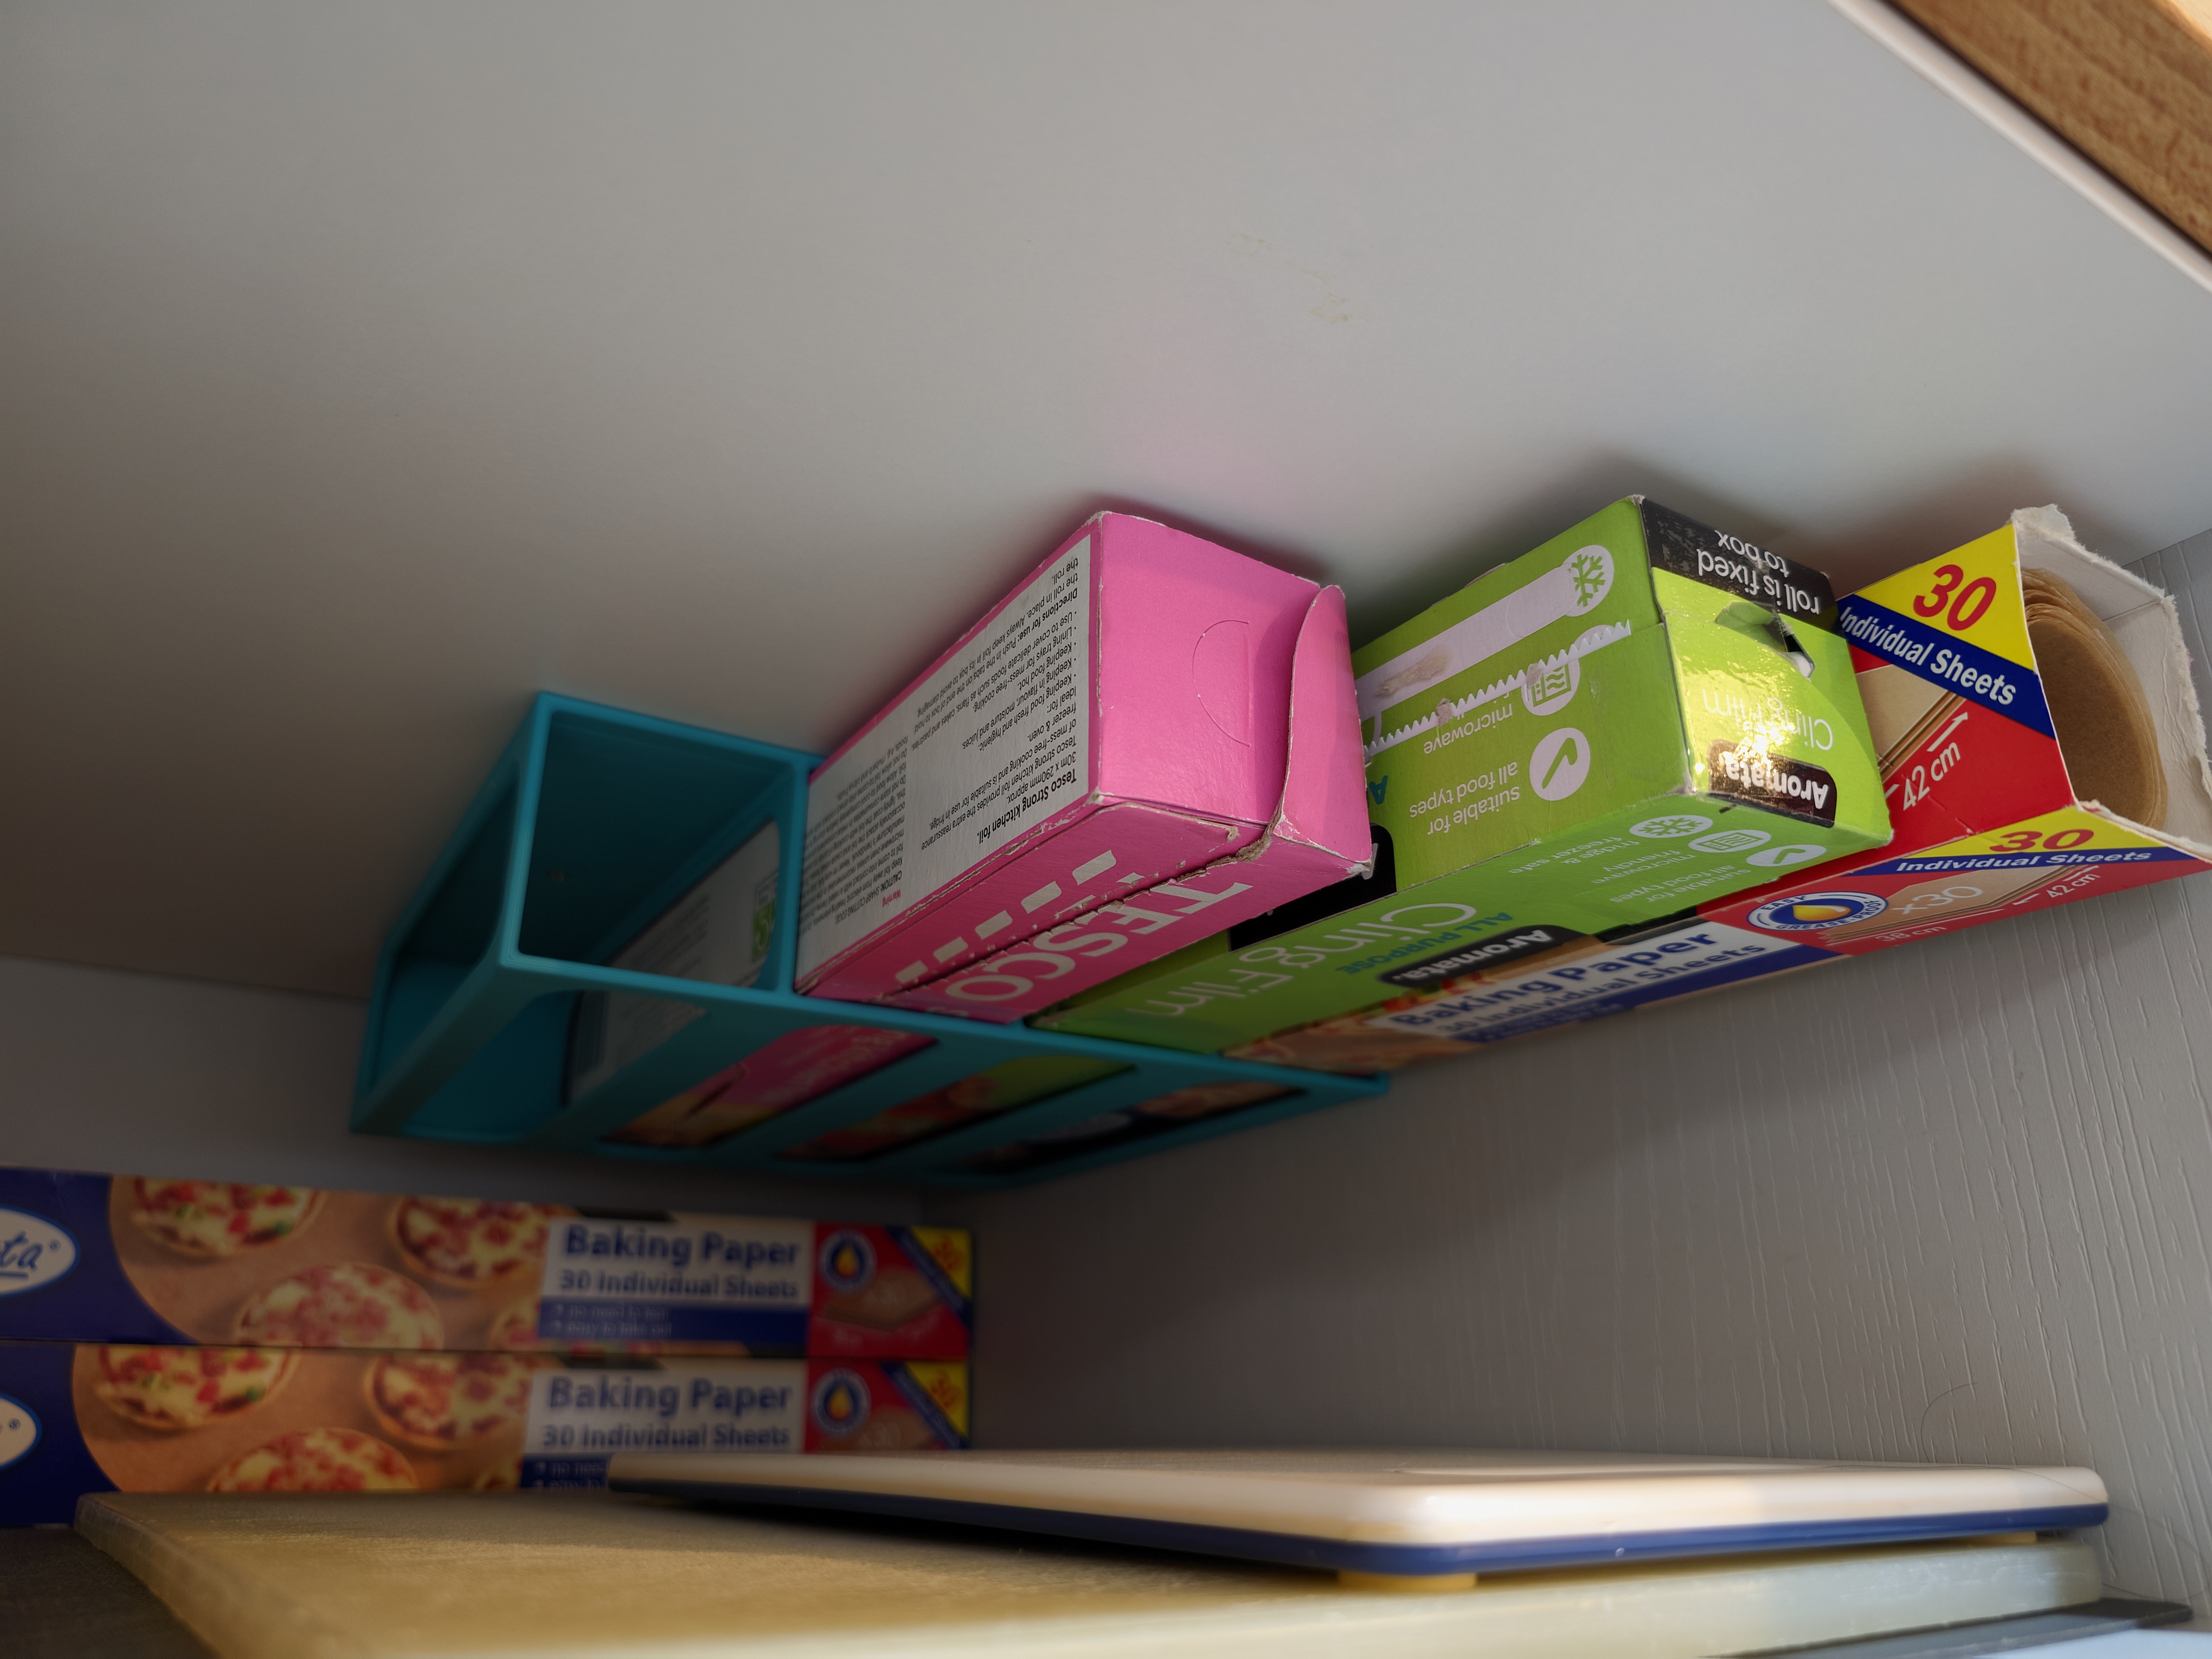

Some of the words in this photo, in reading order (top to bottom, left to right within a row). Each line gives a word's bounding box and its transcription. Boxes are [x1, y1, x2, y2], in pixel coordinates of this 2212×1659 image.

[1714, 530, 1761, 569] box
[1066, 557, 1078, 571] the
[1696, 549, 1760, 595] fixed
[1764, 551, 1789, 578] to
[1052, 567, 1064, 584] roll.
[1066, 573, 1078, 587] the
[1046, 593, 1052, 603] in
[1053, 582, 1064, 600] roll
[1763, 575, 1782, 606] is
[1784, 583, 1819, 615] roll
[1913, 564, 1996, 631] 30
[1026, 597, 1044, 618] place.
[1042, 587, 1077, 621] Directions
[1006, 615, 1025, 637] Always
[1031, 616, 1040, 631] for
[1051, 622, 1058, 633] to
[1060, 612, 1072, 626] Use
[992, 633, 1005, 650] keep
[1018, 626, 1030, 641] use:
[1032, 629, 1050, 649] cover
[1053, 626, 1071, 648] Lining
[982, 646, 991, 661] foil
[996, 650, 1001, 660] in
[1002, 637, 1015, 655] Push
[1036, 642, 1051, 660] trays
[1046, 641, 1071, 668] Keeping
[1840, 607, 1934, 666] Individual
[1930, 649, 2016, 705] Sheets
[976, 654, 981, 664] in
[986, 656, 995, 668] the
[1008, 645, 1031, 668] delicate
[1026, 656, 1034, 670] for
[959, 666, 968, 679] box
[973, 665, 985, 679] tabs
[991, 665, 1006, 684] foods
[995, 664, 1024, 693] mess-free
[1031, 663, 1044, 683] food
[1046, 657, 1071, 683] Keeping
[953, 676, 958, 685] to
[956, 682, 964, 695] the
[966, 676, 972, 686] on
[978, 679, 989, 696] such
[1017, 675, 1029, 691] hot.
[1039, 678, 1044, 688] in
[1046, 673, 1071, 699] Keeping
[946, 691, 955, 706] end
[970, 691, 976, 701] as
[973, 689, 994, 712] cooking.
[1016, 684, 1037, 706] flavour,
[1030, 693, 1044, 713] food
[1060, 686, 1076, 706] Ideal
[931, 705, 940, 717] box
[940, 700, 945, 712] of
[991, 702, 1014, 727] moisture
[1014, 705, 1028, 724] fresh
[1046, 699, 1058, 713] for:
[1052, 702, 1076, 725] freezer
[925, 713, 930, 722] to
[941, 709, 955, 725] cakes
[1002, 718, 1012, 735] and
[1046, 721, 1050, 731] &
[1069, 718, 1076, 732] of
[931, 721, 940, 736] and
[979, 722, 989, 739] and
[1027, 725, 1044, 742] oven.
[1034, 724, 1067, 753] mess-free
[1423, 704, 1513, 754] microwave
[978, 728, 1001, 751] hygienic.
[1056, 735, 1076, 754] Tesco
[1009, 749, 1032, 771] cooking
[1034, 749, 1054, 769] strong
[1055, 762, 1059, 771] x
[1060, 751, 1076, 767] 30m
[992, 775, 996, 785] is
[998, 766, 1008, 783] and
[1011, 763, 1033, 785] kitchen
[1030, 765, 1053, 788] 290mm
[1051, 768, 1076, 792] Tesco
[1499, 762, 1517, 785] all
[1903, 765, 1930, 811] 42
[1930, 742, 1961, 781] cm
[970, 779, 991, 801] suitable
[1001, 780, 1009, 795] foil
[1006, 782, 1028, 803] approx.
[1456, 772, 1496, 803] food
[951, 802, 960, 814] use
[977, 785, 1000, 811] provides
[1022, 786, 1049, 812] Strong
[1410, 788, 1454, 818] types
[1453, 786, 1520, 825] suitable
[946, 809, 950, 819] in
[952, 813, 966, 828] extra
[967, 806, 975, 818] the
[992, 804, 1020, 831] kitchen
[977, 825, 990, 844] foil.
[1427, 815, 1450, 835] for
[921, 823, 951, 850] reassurance
[1989, 828, 2094, 853] 30
[1551, 837, 1622, 860] freezer
[1581, 840, 1639, 859] fridge
[1508, 859, 1550, 874] safe
[1591, 853, 1696, 884] microwave
[1603, 850, 1681, 872] friendly
[1709, 865, 1735, 874] all
[1896, 856, 2042, 872] Individual
[2045, 850, 2151, 865] Sheets
[1661, 872, 1711, 887] food
[1672, 869, 1751, 893] suitable
[2045, 884, 2074, 899] 42
[2070, 872, 2100, 888] cm
[1609, 884, 1664, 903] types
[1646, 892, 1675, 903] for
[1761, 895, 1808, 911] EASY
[1891, 885, 1982, 915] x30
[1454, 912, 1513, 931] ALL
[1775, 898, 1888, 931] GREASE-PROOF
[946, 872, 1253, 1001] TESCO
[1238, 903, 1476, 968] Cling
[1911, 925, 1947, 937] cm
[1335, 931, 1462, 974] PURPOSE
[1390, 979, 1562, 1026] Baking
[1548, 930, 1718, 981] Paper
[1474, 976, 1639, 1026] Individual
[1636, 941, 1767, 980] Sheets
[1126, 969, 1294, 1017] Film
[564, 1224, 692, 1267] Baking
[700, 1231, 800, 1269] Paper
[560, 1268, 592, 1291] 30
[599, 1269, 719, 1295] Individual
[725, 1274, 798, 1299] Sheets
[548, 1376, 680, 1419] Baking
[691, 1379, 792, 1422] Paper
[542, 1424, 576, 1449] 30
[582, 1424, 708, 1450] Individual
[714, 1425, 790, 1450] Sheets
